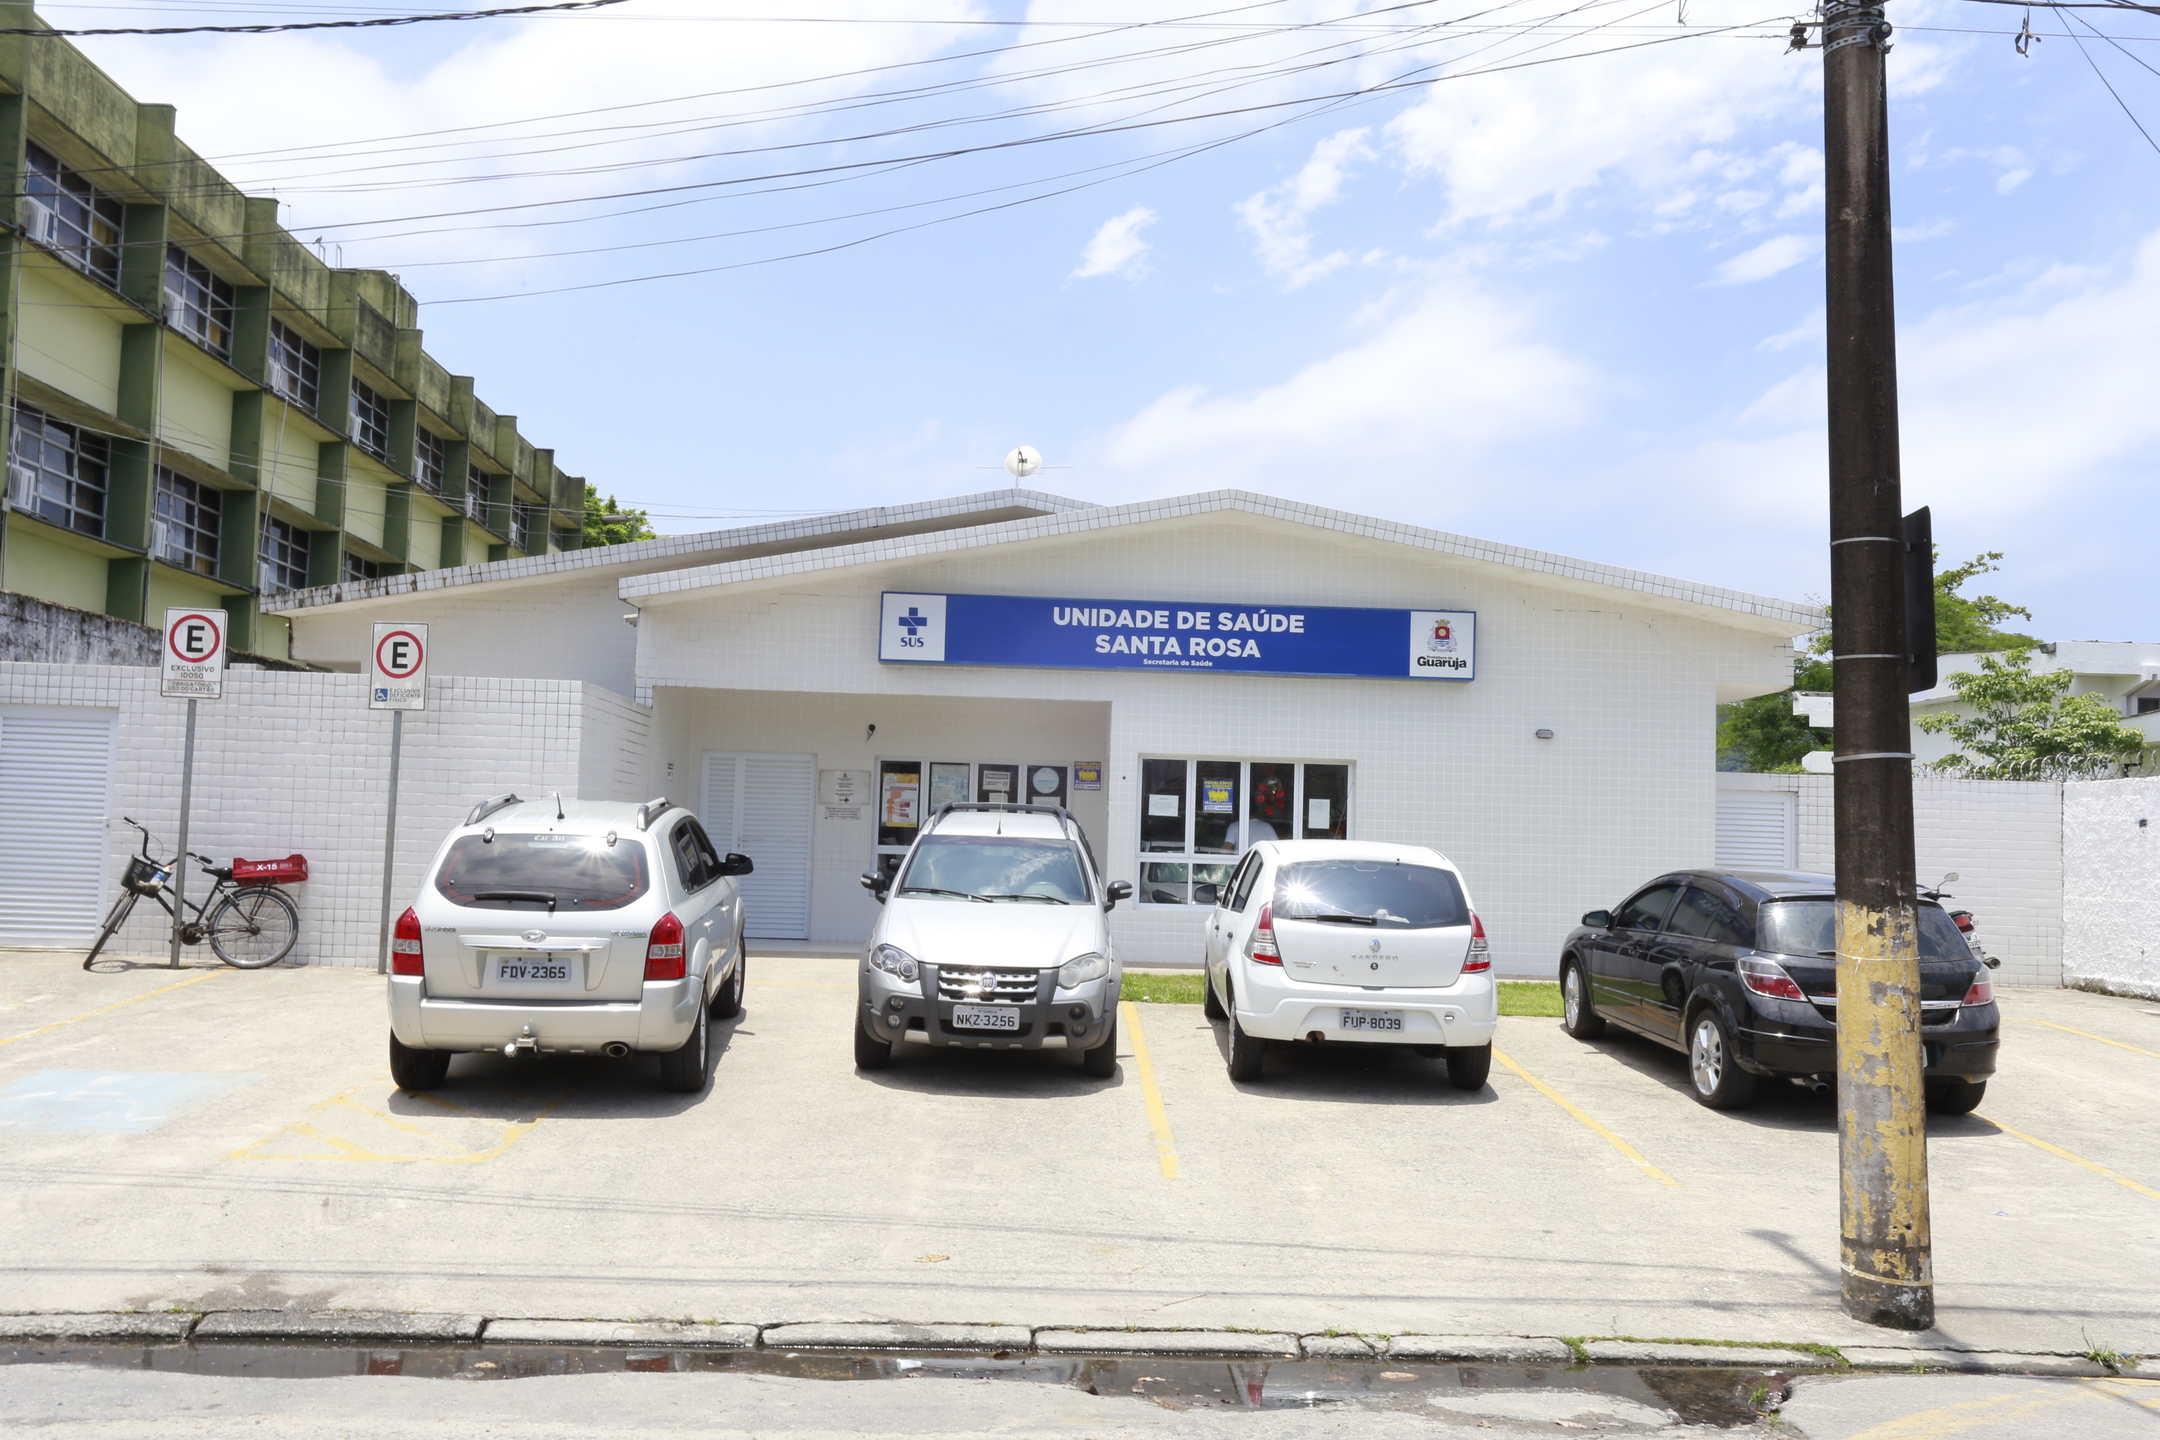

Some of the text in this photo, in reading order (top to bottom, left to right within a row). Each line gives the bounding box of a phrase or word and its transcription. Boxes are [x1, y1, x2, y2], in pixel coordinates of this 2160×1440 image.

[1053, 606, 1305, 633] UNIDADE DE SAÚDE
[186, 625, 205, 653] E
[900, 636, 924, 648] SUS
[1095, 634, 1261, 658] SANTA ROSA
[391, 641, 409, 669] E
[256, 863, 278, 871] X-15
